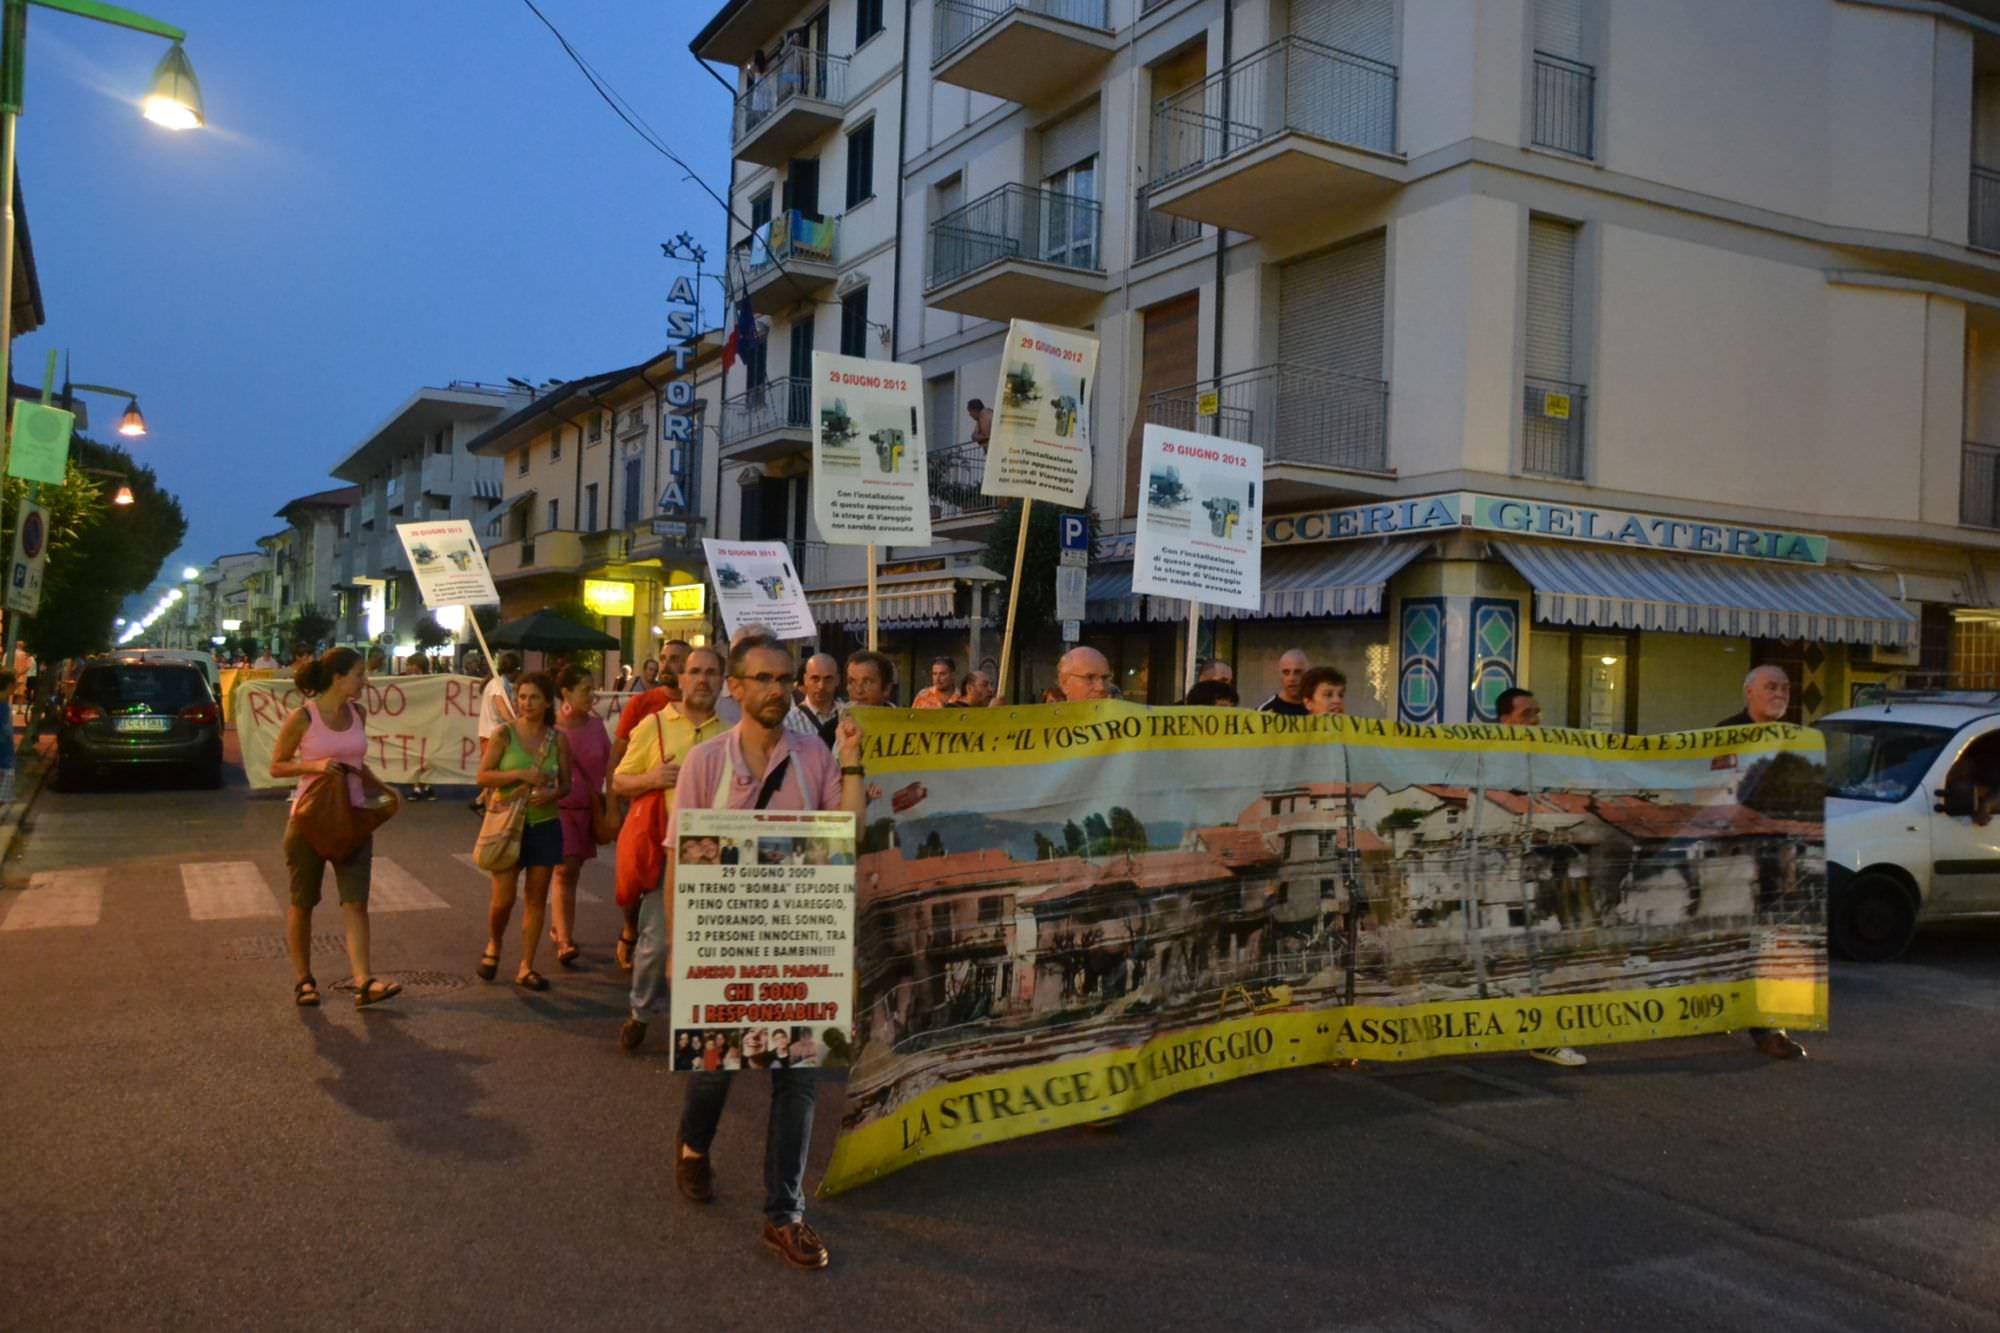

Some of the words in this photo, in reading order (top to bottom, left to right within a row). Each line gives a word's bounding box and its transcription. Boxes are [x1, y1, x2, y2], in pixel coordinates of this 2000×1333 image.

[1062, 349, 1083, 363] 2012
[658, 276, 696, 507] ASTORIA
[829, 371, 841, 383] 29
[842, 373, 881, 389] GIUGNO
[883, 378, 907, 391] 2012
[1161, 442, 1175, 453] 29
[1177, 444, 1219, 461] GIUGNO
[1222, 453, 1248, 467] 2012
[1065, 518, 1083, 547] P
[1262, 499, 1458, 544] CCERIA
[1487, 500, 1818, 564] GELATERIA
[248, 683, 407, 727] RICDO
[1043, 715, 1142, 750] VOSTRO
[1147, 714, 1220, 737] TRENO
[1224, 714, 1256, 736] HA
[1350, 716, 1386, 737] VIA
[1393, 721, 1437, 739] MIA
[1443, 725, 1536, 742] SORELLA
[1658, 733, 1671, 751] E
[1678, 731, 1698, 750] 31
[722, 867, 736, 878] 29
[739, 867, 785, 879] GIUGNO
[788, 867, 816, 879] 2009
[678, 883, 696, 894] UN
[700, 883, 736, 894] TRENO
[795, 883, 840, 894] ESPLODE
[843, 883, 856, 894] IN
[687, 899, 723, 910] PIENO
[726, 899, 769, 910] CENTRO
[772, 899, 781, 909] A
[783, 899, 847, 911] VIAREGGIO,
[697, 914, 768, 927] DIVORANDO,
[771, 915, 793, 926] NEL
[795, 915, 838, 927] SONNO,
[704, 930, 756, 942] PERSONE
[759, 930, 823, 942] INNOCENTI,
[826, 930, 847, 941] TRA
[697, 946, 717, 958] CUI
[720, 946, 760, 957] DONNE
[763, 946, 769, 957] E
[724, 982, 754, 1002] CHI
[759, 981, 809, 1001] SONO
[692, 1005, 700, 1024] I
[704, 1001, 839, 1024] RESPONSABILI?
[902, 1108, 932, 1150] LA
[939, 1071, 1100, 1130] STRAGE
[1105, 1061, 1142, 1097] DI
[1516, 1007, 1543, 1034] 29
[1556, 998, 1665, 1031] GIUGNO
